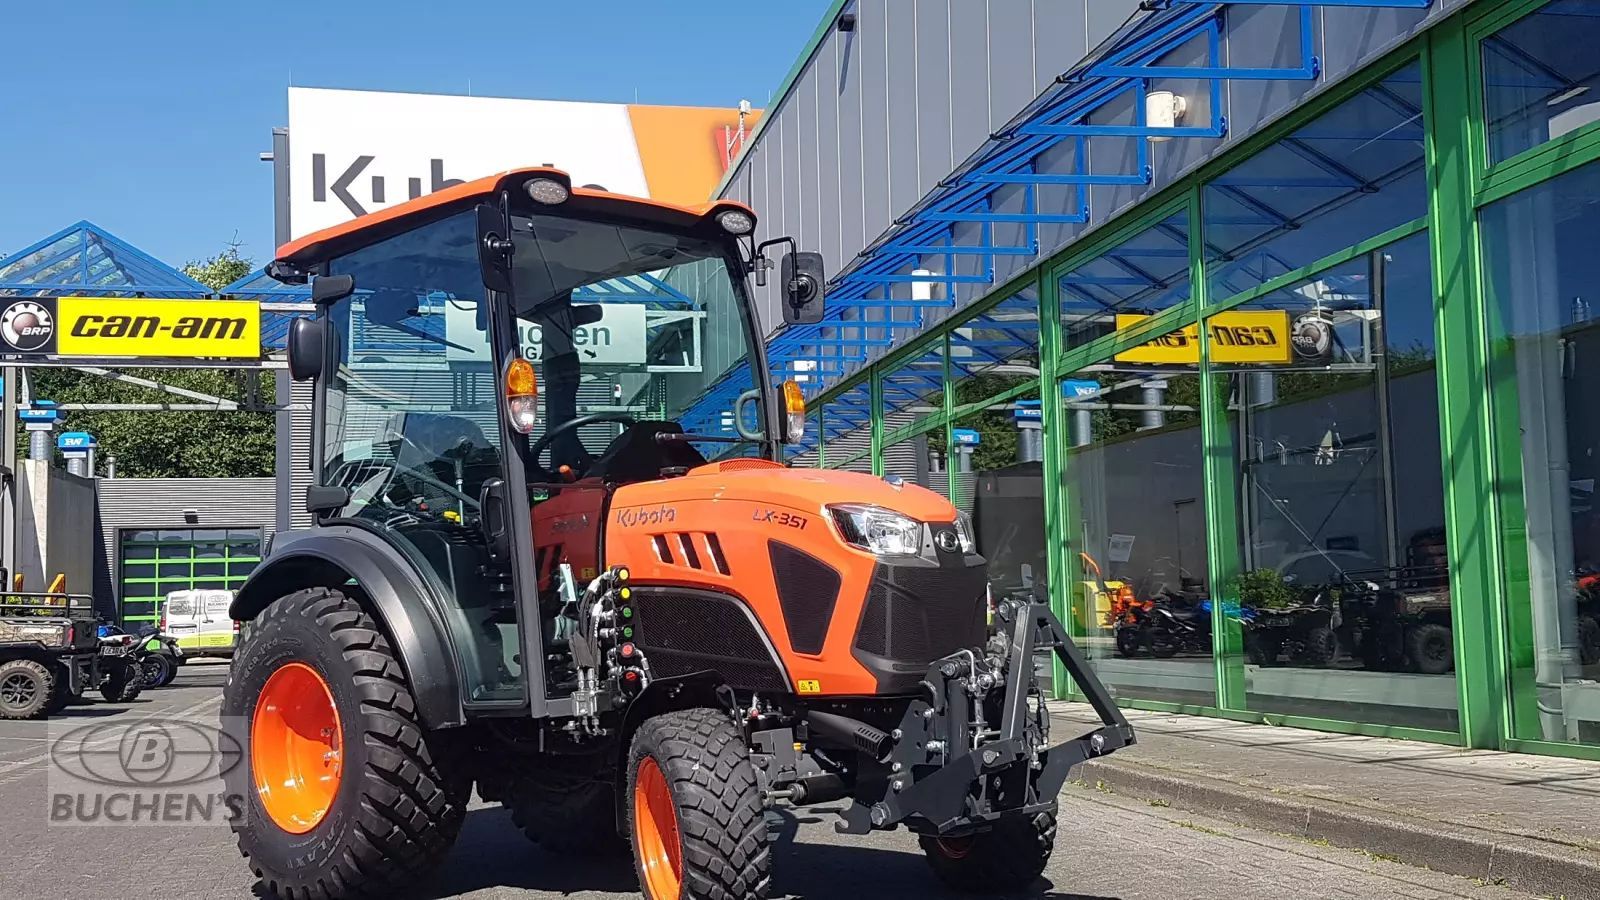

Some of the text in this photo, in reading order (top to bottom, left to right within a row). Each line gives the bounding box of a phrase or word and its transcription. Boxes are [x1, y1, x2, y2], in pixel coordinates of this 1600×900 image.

[21, 326, 51, 336] BRP
[70, 315, 247, 339] can-am
[617, 505, 675, 527] Kubota
[752, 508, 808, 530] LX-351
